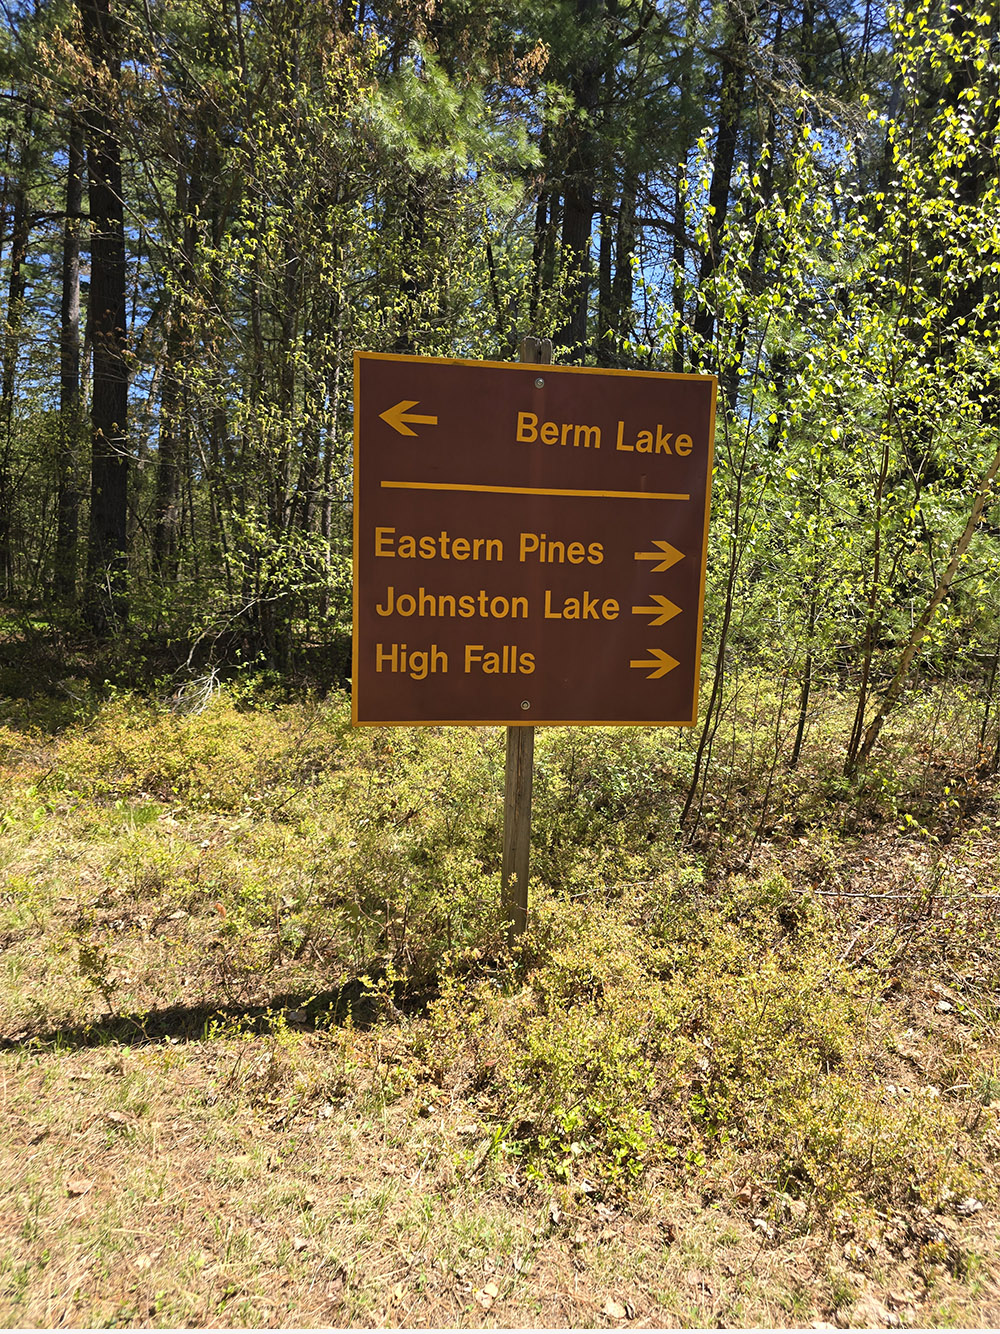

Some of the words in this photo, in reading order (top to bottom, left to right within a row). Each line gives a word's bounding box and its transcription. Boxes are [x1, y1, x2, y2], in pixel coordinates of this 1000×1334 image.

[516, 411, 601, 449] Berm
[616, 420, 693, 457] Lake
[375, 527, 503, 562] Eastern
[519, 532, 605, 565] Pines
[375, 587, 529, 619] Johnston
[544, 590, 620, 620] Lake
[375, 643, 448, 680] High
[464, 645, 536, 675] Falls
